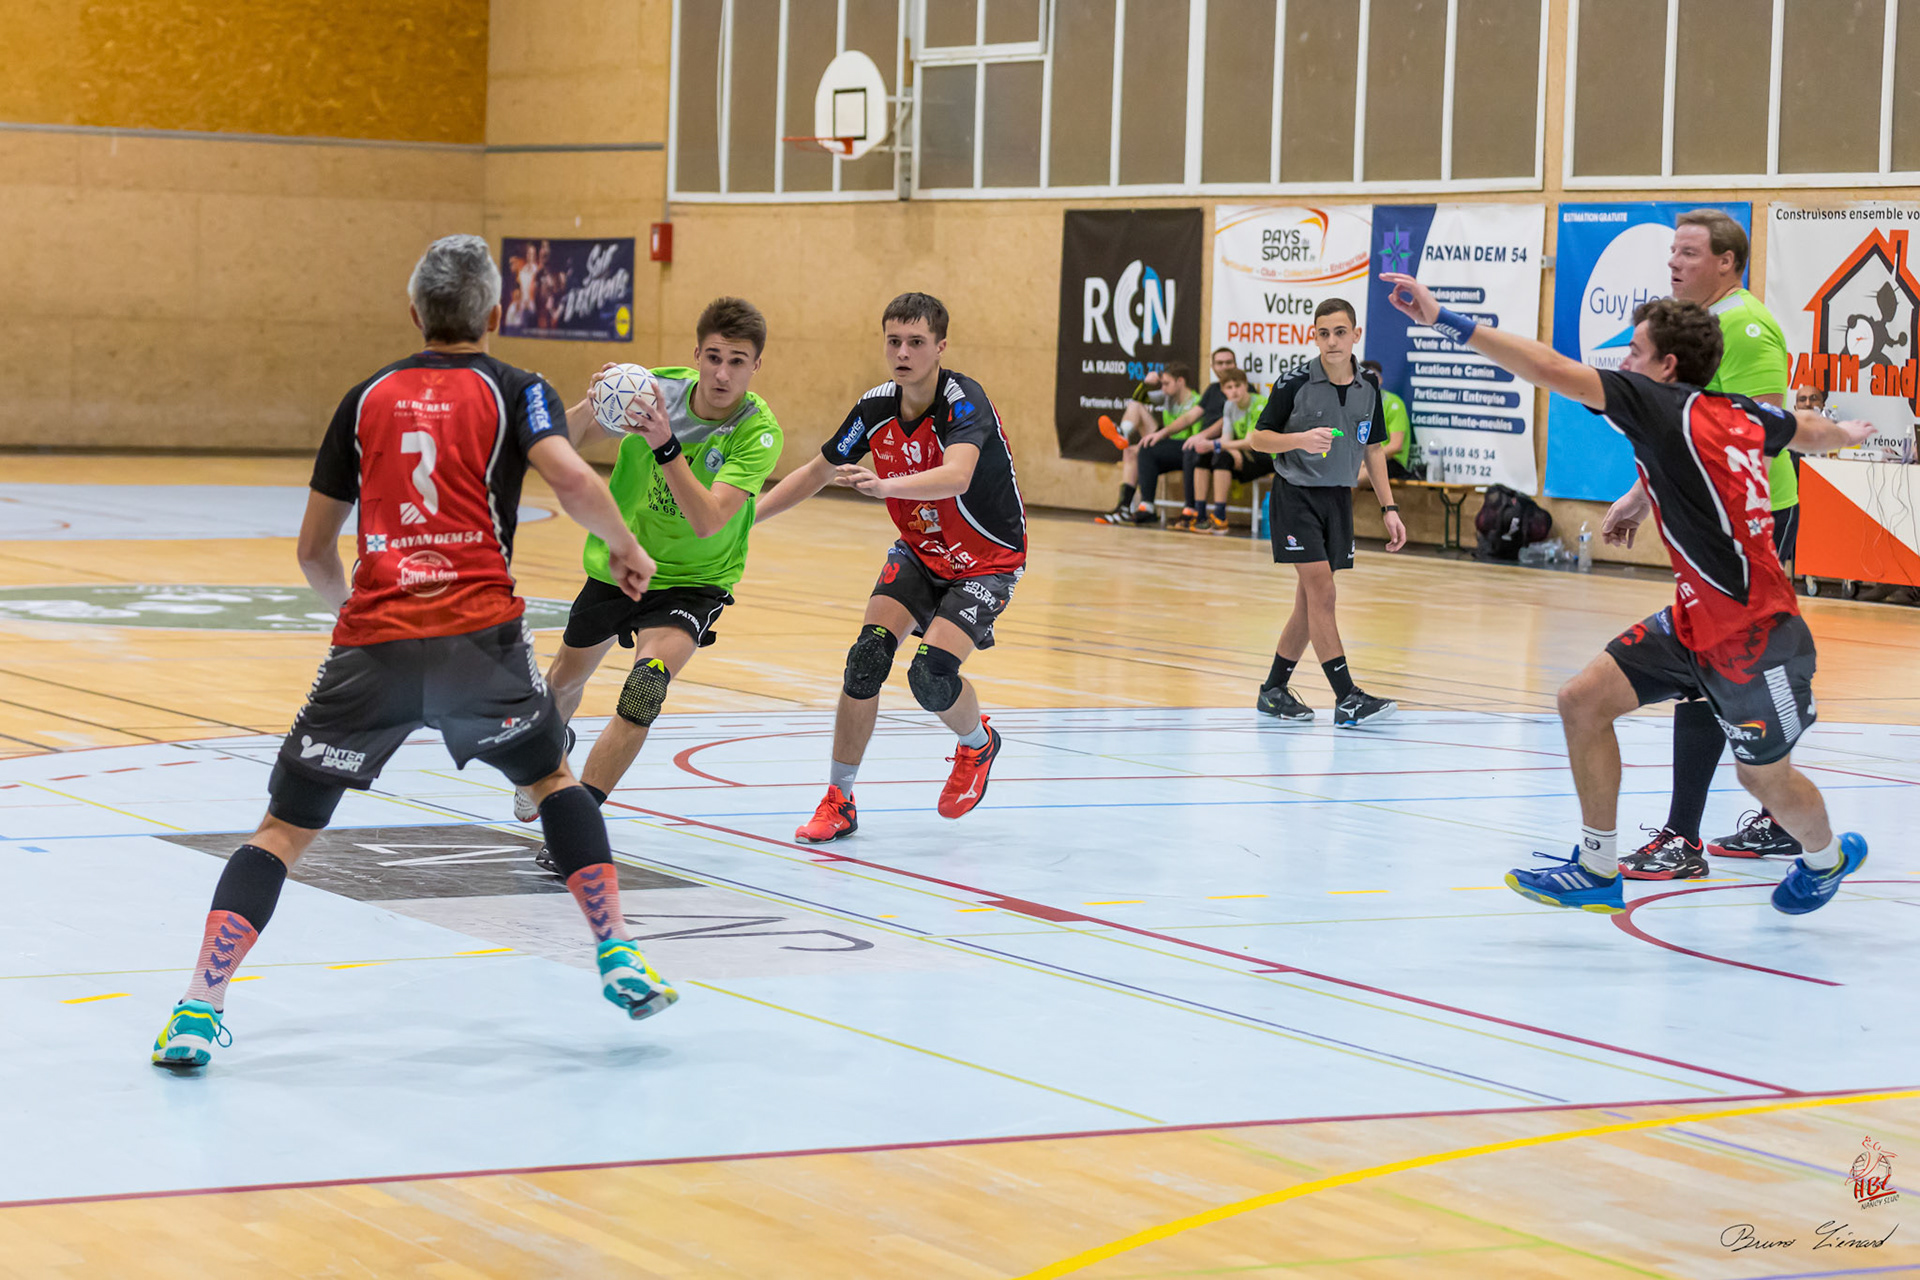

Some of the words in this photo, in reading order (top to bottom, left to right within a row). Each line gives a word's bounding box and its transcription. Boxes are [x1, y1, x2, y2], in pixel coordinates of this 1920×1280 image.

[1776, 208, 1847, 220] Construisons
[1850, 207, 1903, 220] ensemble
[1262, 229, 1301, 244] PAYS
[1426, 246, 1470, 261] RAYAN
[1475, 246, 1506, 262] DEM
[1511, 248, 1527, 262] 54
[1264, 292, 1313, 314] Votre
[1589, 286, 1628, 320] Guy
[1082, 360, 1095, 373] LA
[1096, 361, 1127, 375] RADIO
[1243, 353, 1263, 373] de
[1415, 363, 1450, 376] Location
[1464, 365, 1495, 378] Camion
[1870, 358, 1917, 399] and
[1411, 413, 1450, 426] Location
[1483, 449, 1496, 460] 34
[401, 431, 438, 525] 3
[1480, 466, 1491, 477] 22
[391, 534, 432, 548] RAYAN
[434, 532, 463, 544] DEM
[465, 531, 483, 543] 54
[401, 567, 426, 585] Cave
[324, 745, 366, 763] INTER
[321, 756, 362, 772] SPORT
